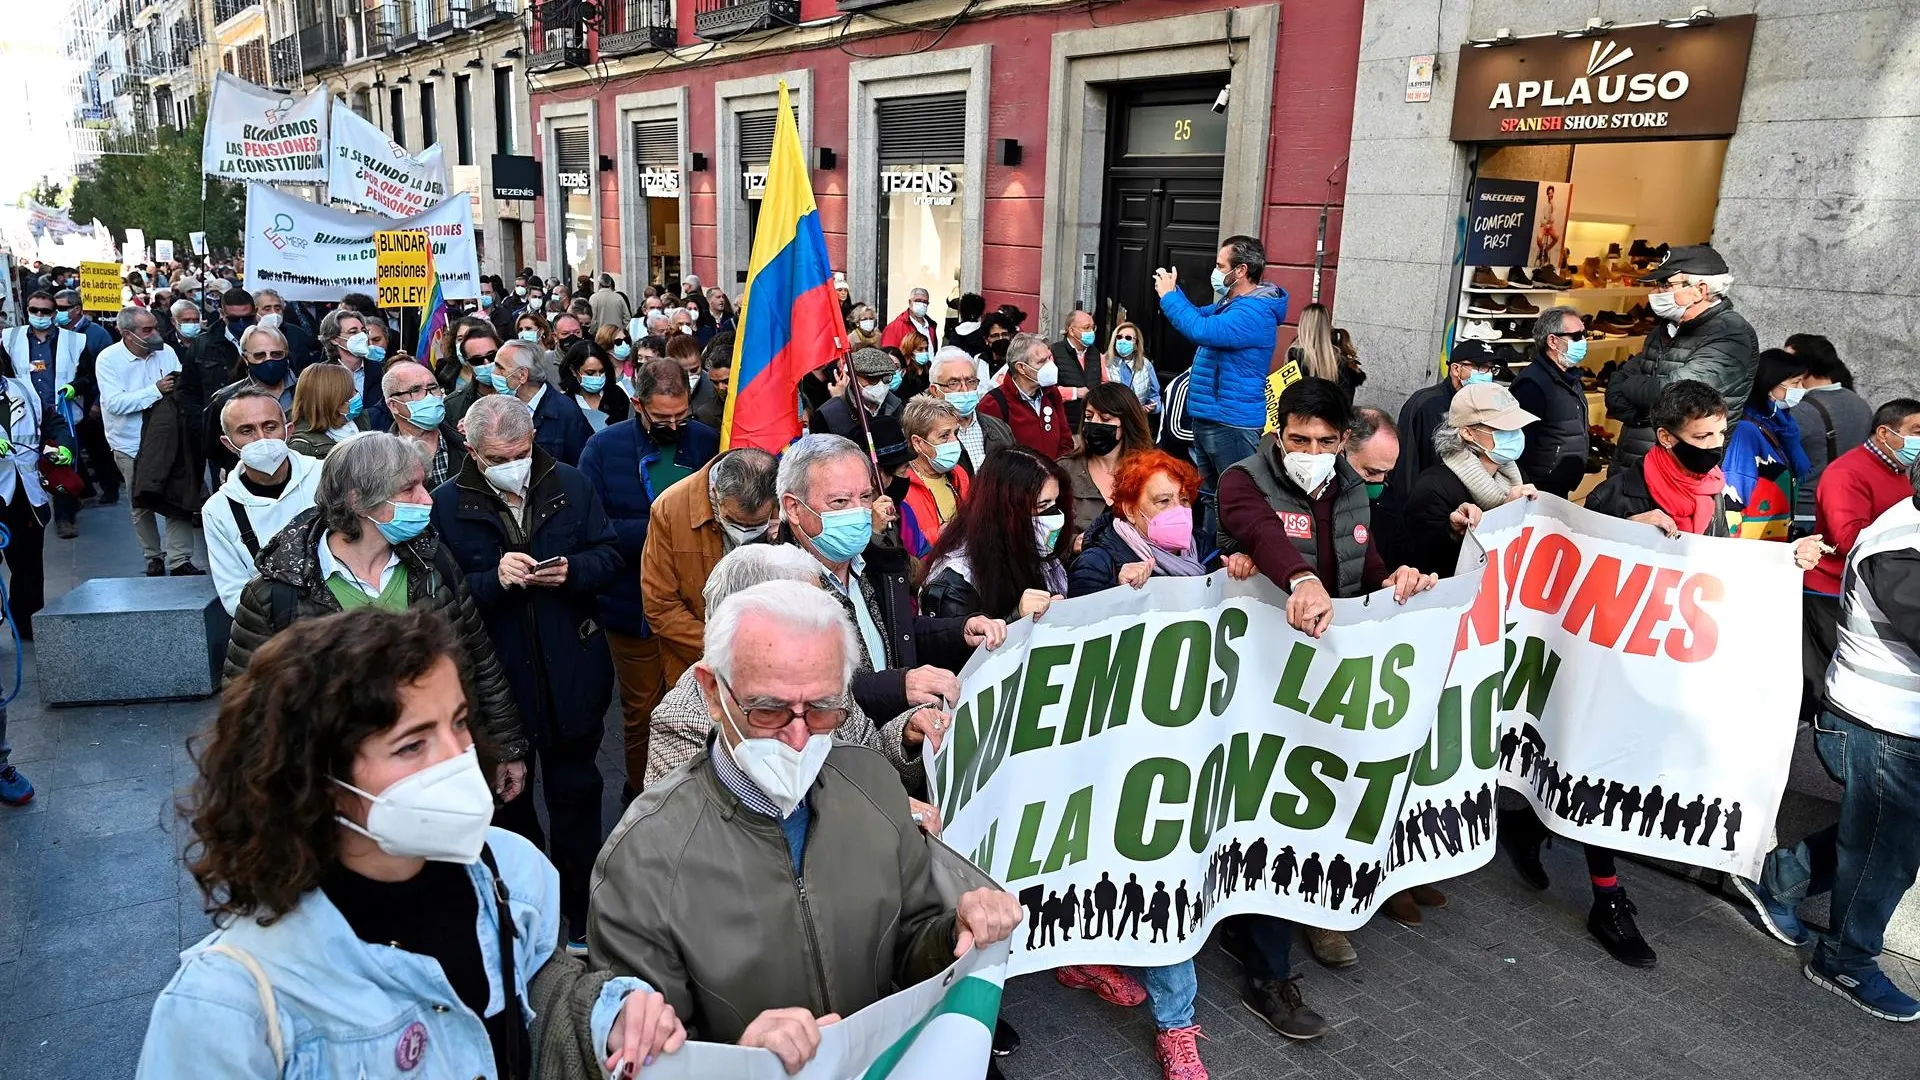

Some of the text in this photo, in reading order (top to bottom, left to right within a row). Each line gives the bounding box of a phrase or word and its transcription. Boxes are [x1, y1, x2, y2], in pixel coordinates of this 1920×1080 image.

[1489, 70, 1689, 109] APLAUSO
[1174, 119, 1192, 140] 25
[1500, 112, 1668, 132] SPANISH SHOE STORE
[226, 141, 243, 156] LAS
[244, 136, 316, 158] PENSIONES
[220, 159, 236, 173] LA
[363, 154, 410, 184] BLINDÓ
[410, 178, 422, 191] LA
[558, 170, 588, 187] TEZENIS
[880, 167, 953, 194] TEZENIS
[380, 181, 404, 198] QUÉ
[404, 191, 423, 205] NO
[496, 187, 534, 197] TEZENIS
[1479, 193, 1526, 203] SKECHERS
[1474, 212, 1525, 233] COMFORT
[1483, 233, 1513, 250] FIRST
[336, 253, 346, 262] EN
[348, 253, 359, 262] LA
[81, 265, 119, 276] Sin excusas
[379, 261, 426, 282] pensiones
[81, 279, 91, 289] de
[380, 286, 426, 304] POR LEY!
[1273, 641, 1415, 731] LAS
[1006, 785, 1093, 882] LA
